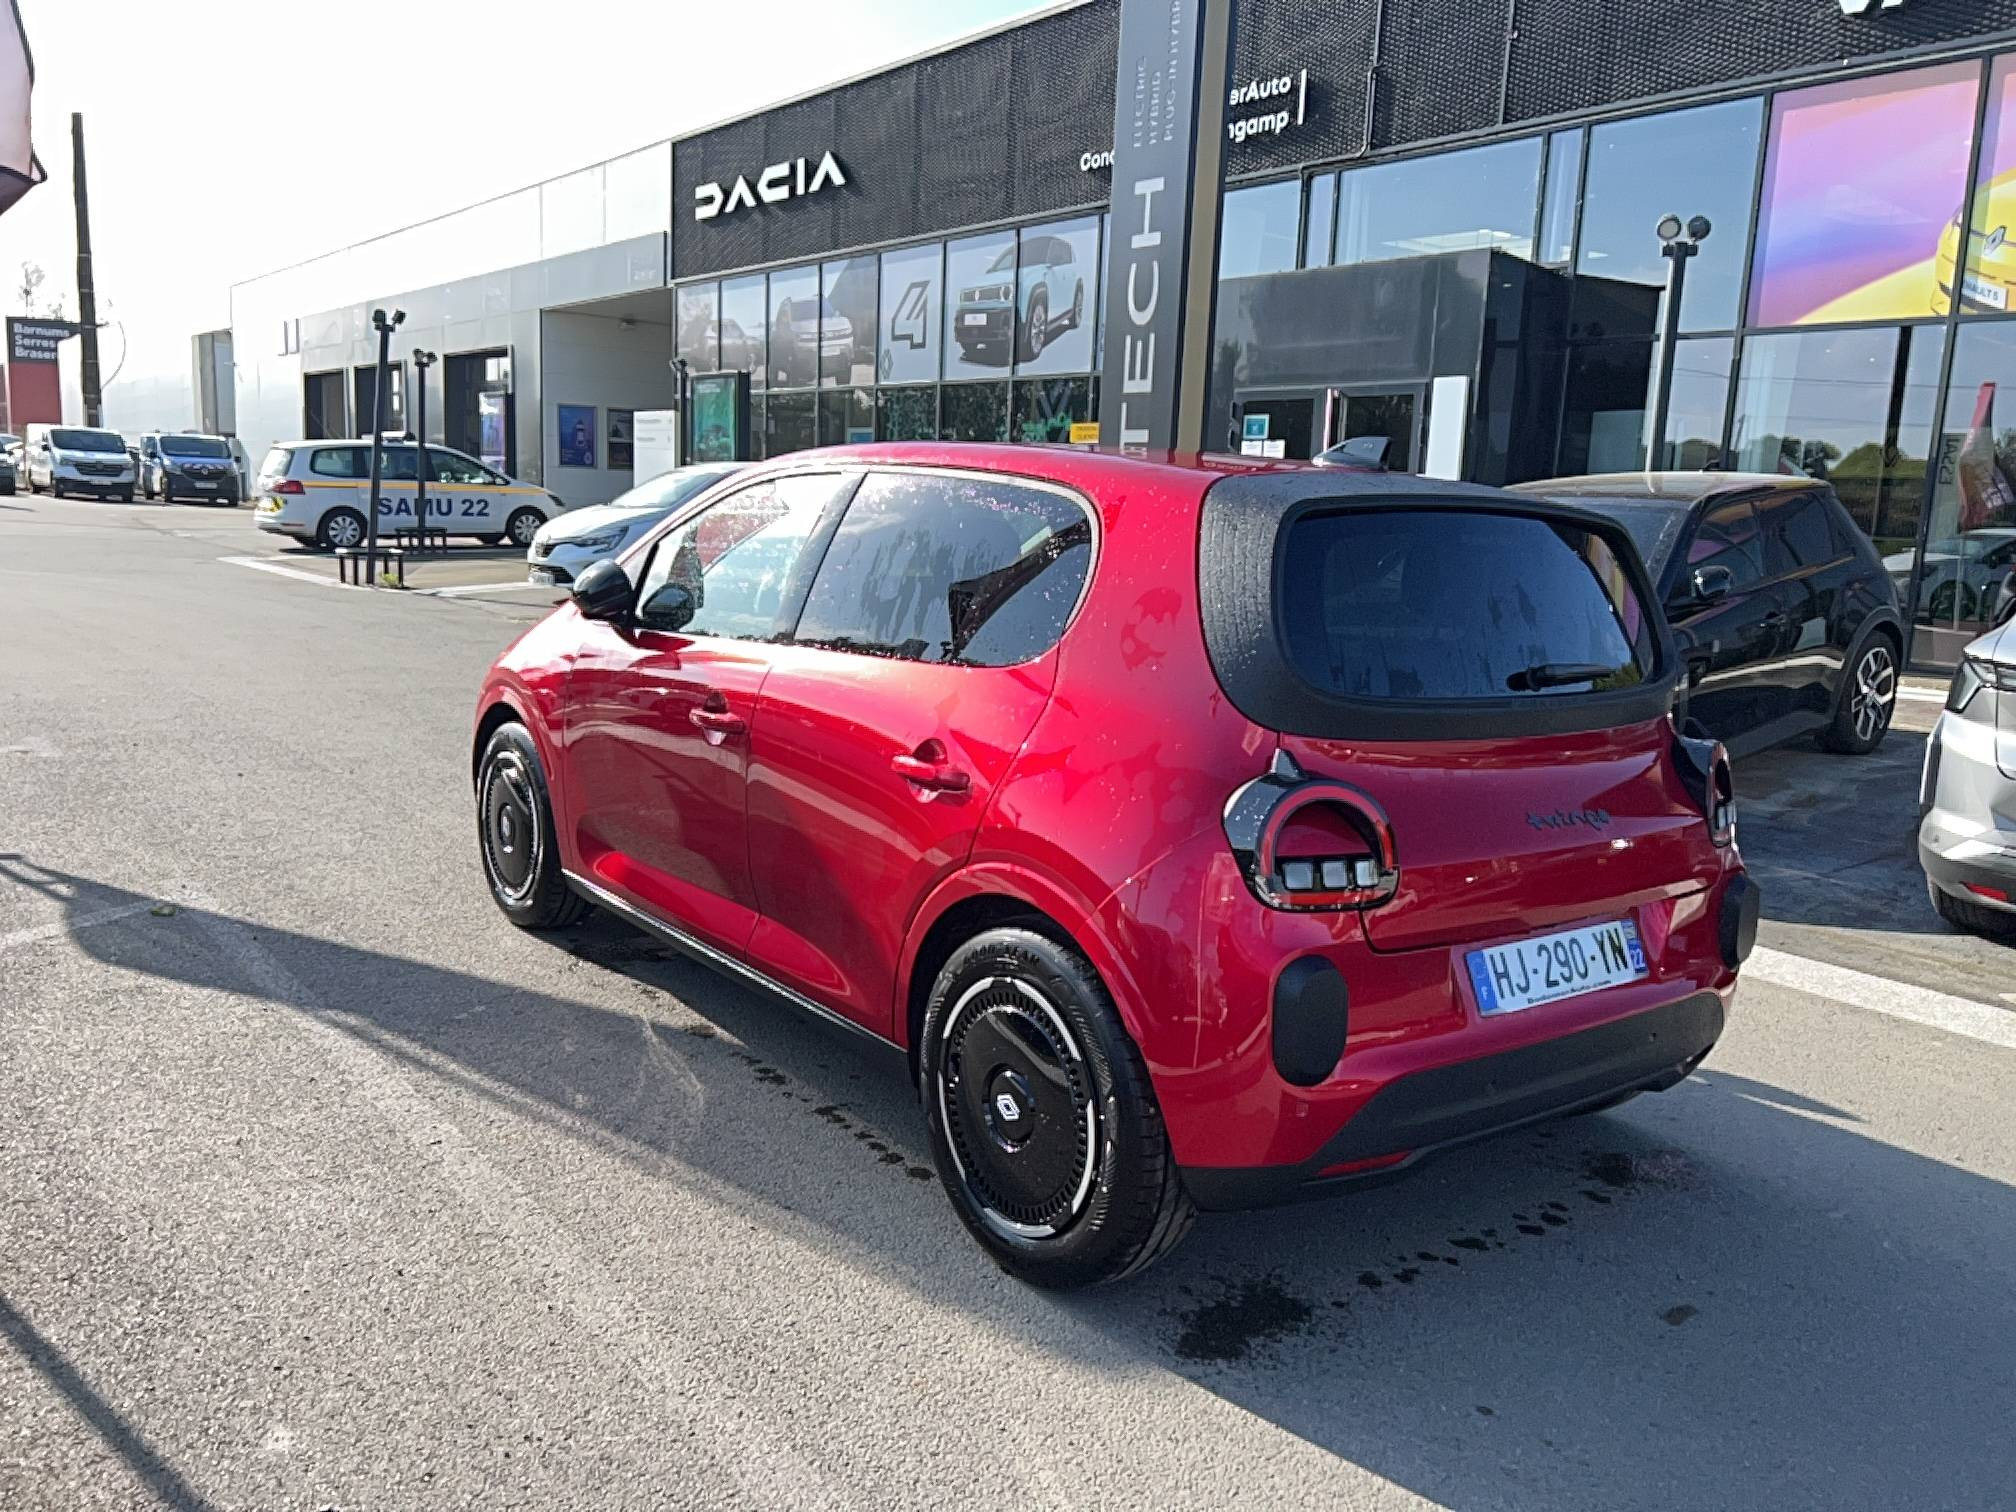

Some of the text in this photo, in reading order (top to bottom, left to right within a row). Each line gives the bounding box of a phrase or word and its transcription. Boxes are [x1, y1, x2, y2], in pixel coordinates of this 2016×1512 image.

[694, 150, 847, 222] DACIA
[378, 497, 490, 517] SAMU 22
[1489, 927, 1629, 1000] HJ-290-YN
